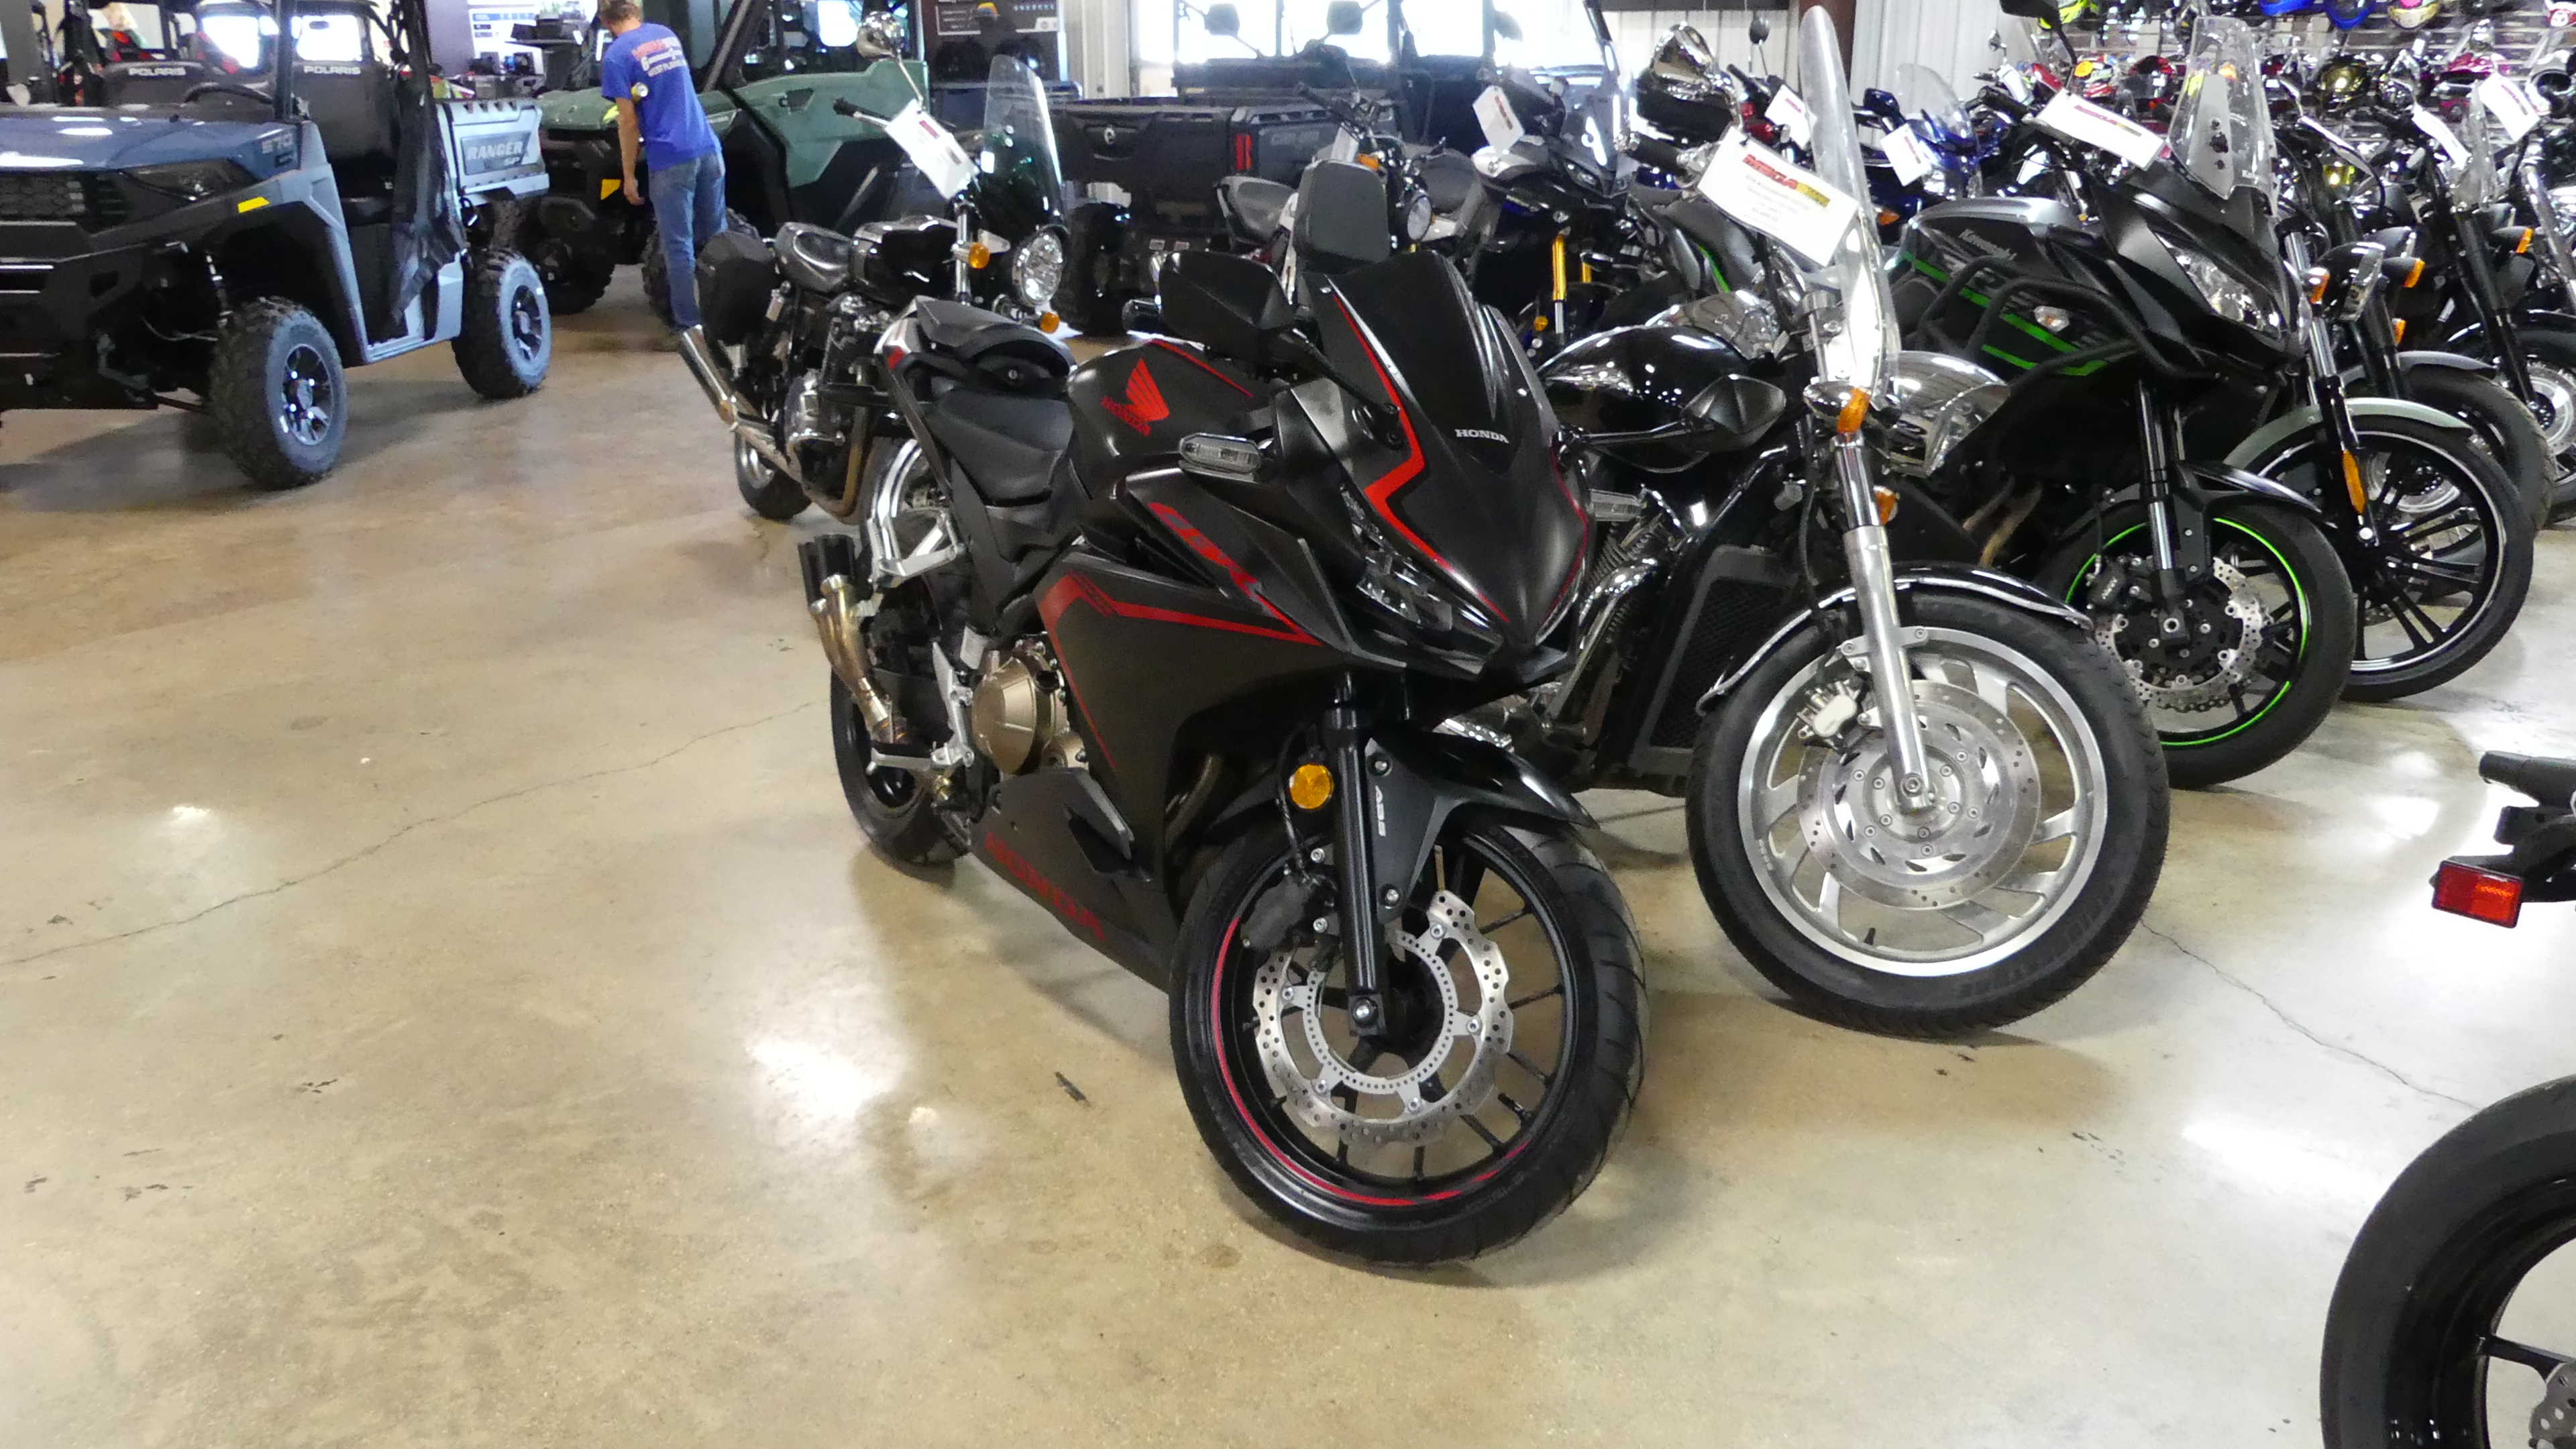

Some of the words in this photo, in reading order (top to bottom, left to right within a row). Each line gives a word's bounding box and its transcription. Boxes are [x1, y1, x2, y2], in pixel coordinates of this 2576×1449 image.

[128, 68, 186, 76] POLARIS
[303, 66, 360, 75] POLARIS
[468, 140, 523, 160] RANGER
[1100, 396, 1151, 437] HONDA
[1454, 429, 1509, 443] HONDA
[1375, 786, 1387, 837] ABS
[985, 831, 1108, 942] HONDA
